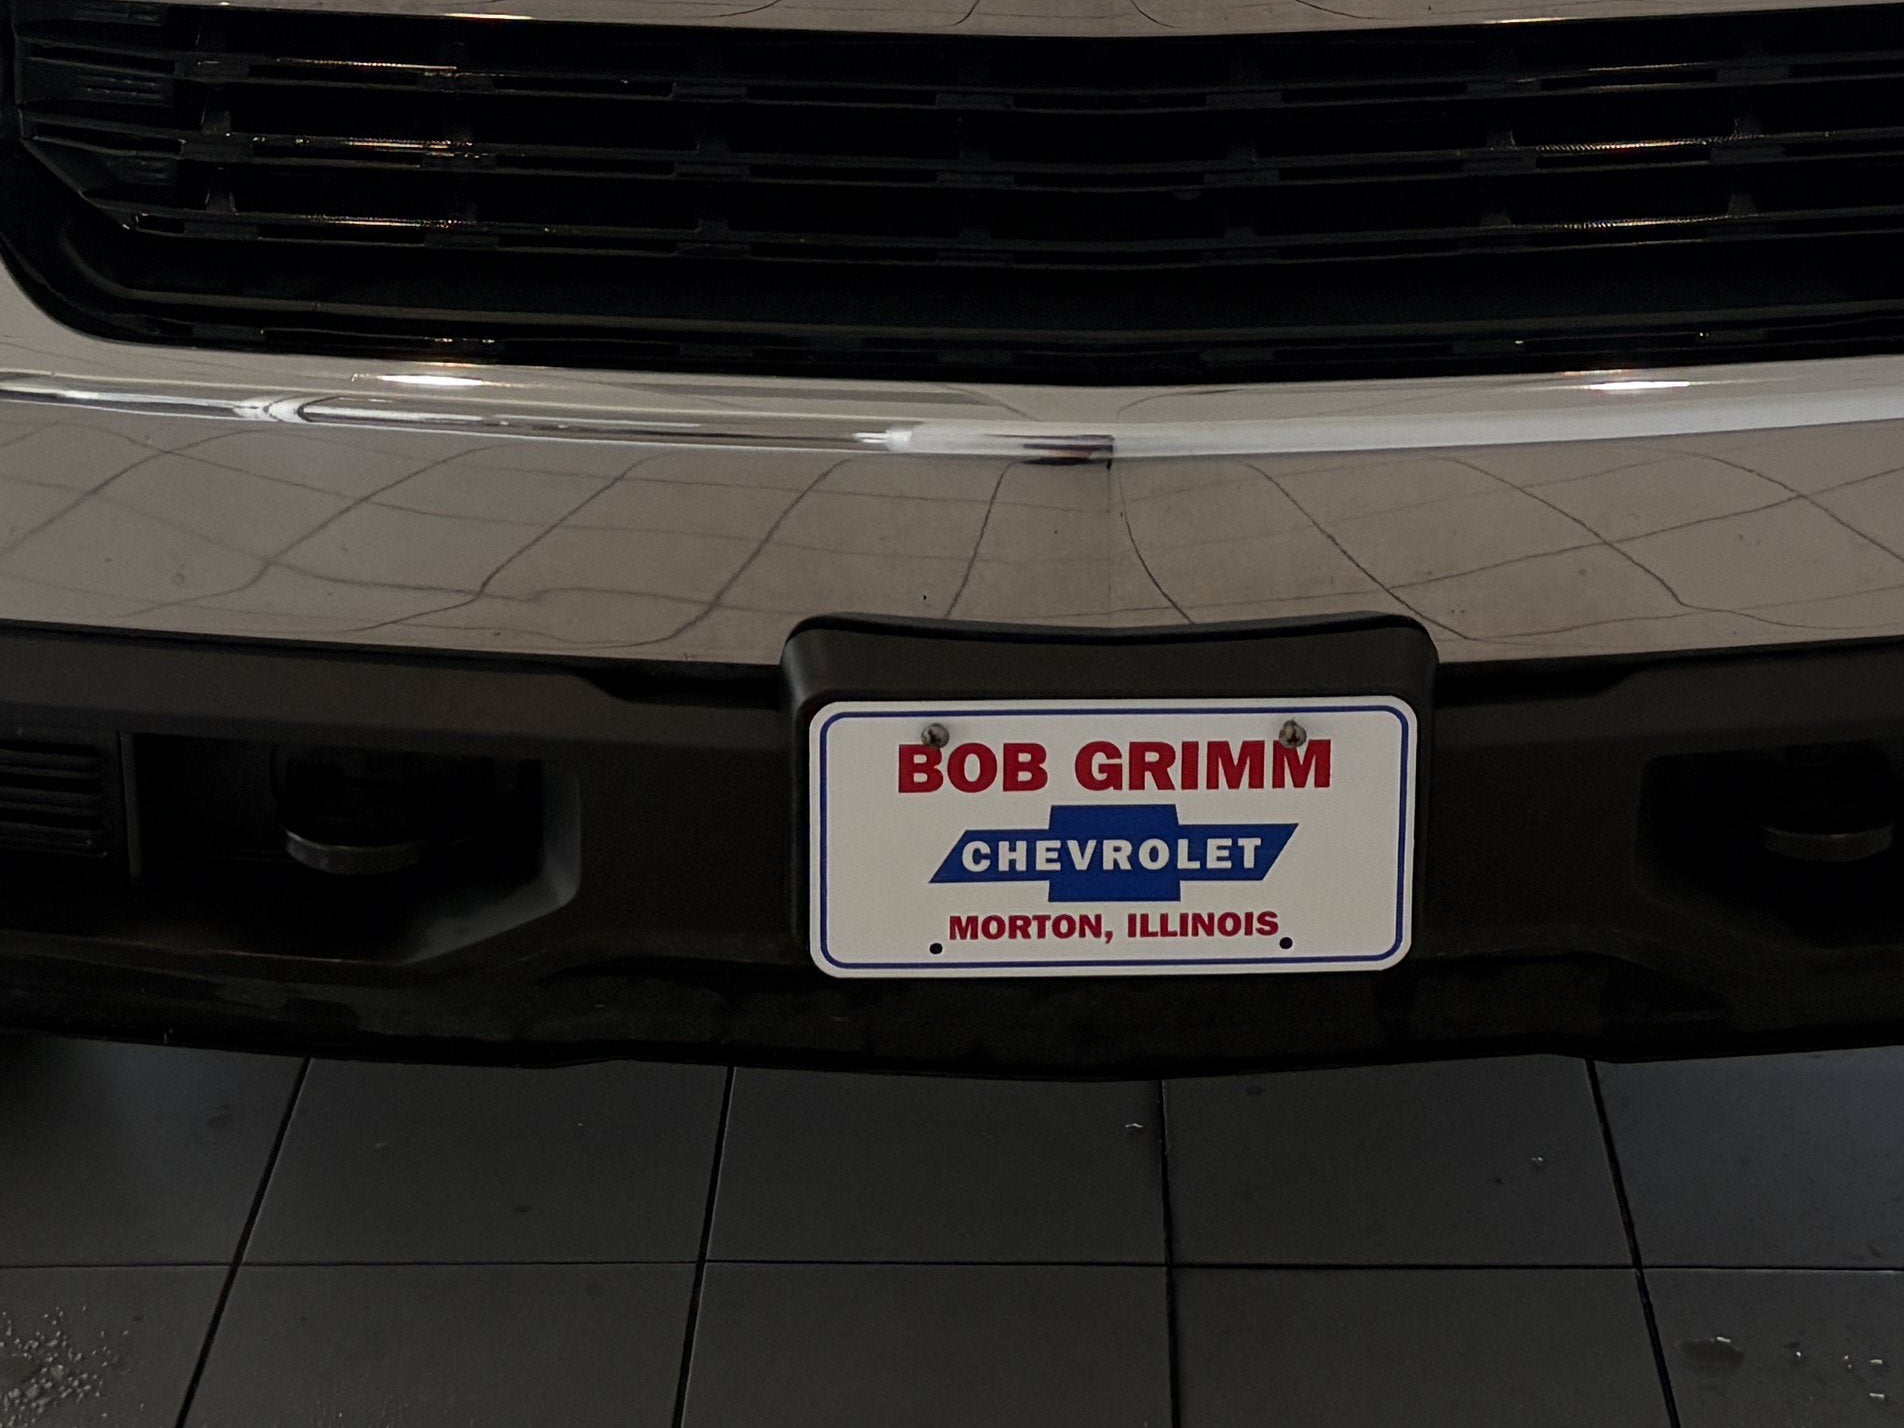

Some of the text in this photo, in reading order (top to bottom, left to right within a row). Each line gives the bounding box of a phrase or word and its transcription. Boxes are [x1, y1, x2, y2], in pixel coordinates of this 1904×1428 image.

[898, 739, 1332, 794] BOB GRIMM
[961, 837, 1263, 873] CHEVROLET
[948, 911, 1280, 944] MORTON, ILLINOIS
